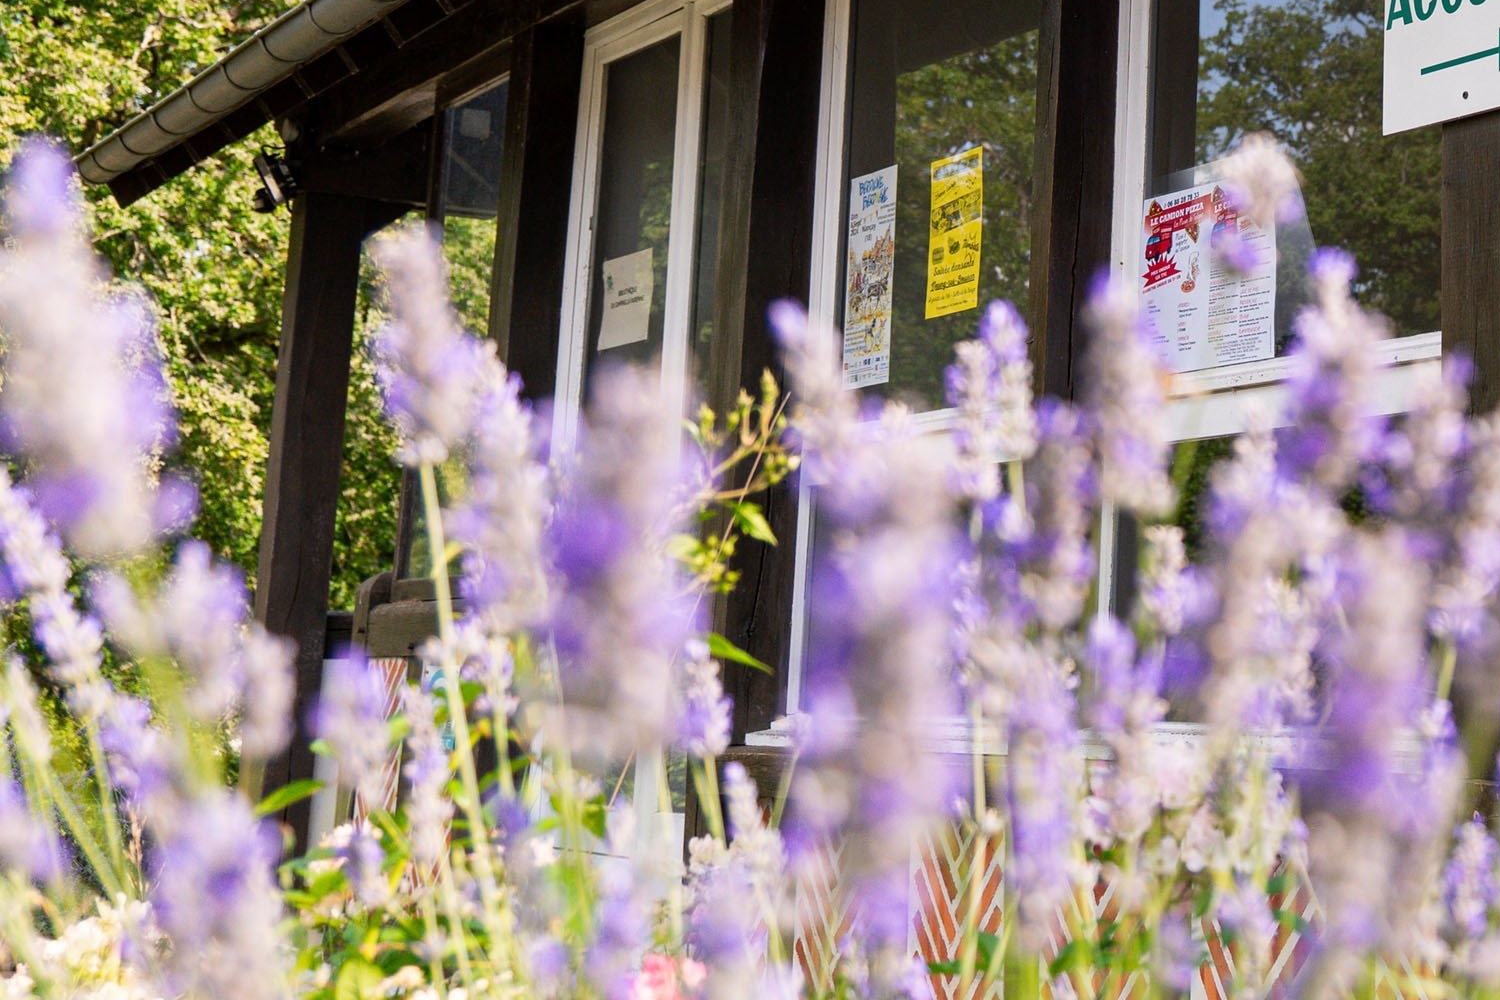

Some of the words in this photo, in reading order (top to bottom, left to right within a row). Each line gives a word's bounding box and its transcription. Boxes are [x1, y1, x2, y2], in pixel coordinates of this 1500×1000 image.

[1150, 218, 1159, 226] LE
[1160, 208, 1184, 223] CAMION
[1185, 202, 1205, 216] PIZZA
